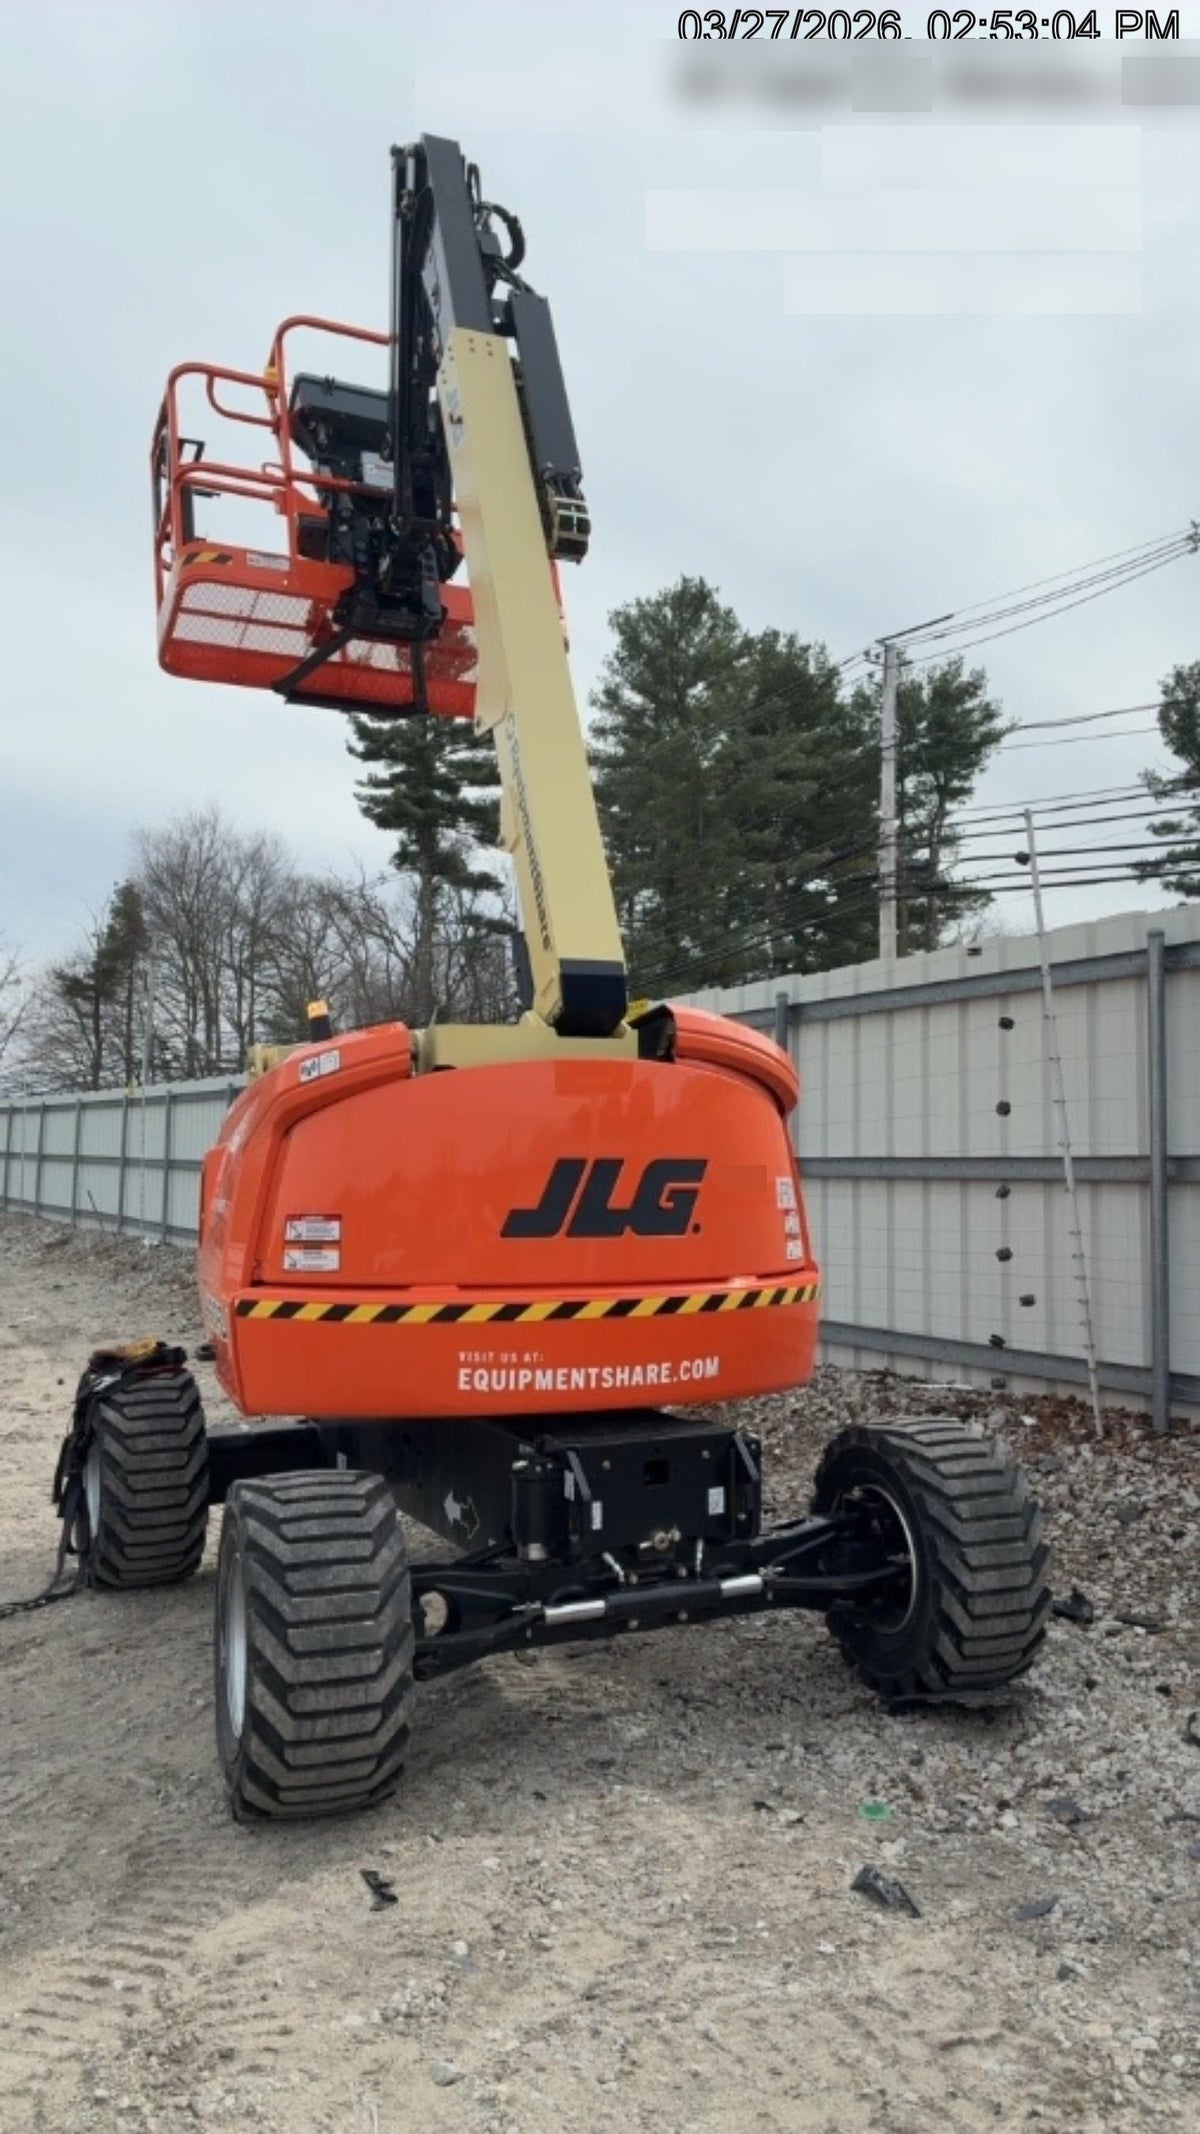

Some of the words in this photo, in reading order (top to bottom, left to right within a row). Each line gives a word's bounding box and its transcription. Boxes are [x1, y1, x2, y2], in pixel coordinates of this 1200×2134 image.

[500, 1158, 709, 1238] JLG
[458, 1356, 720, 1392] EQUIPMENTSHARE.COM
[459, 1351, 494, 1363] VISIT
[500, 1352, 518, 1364] US
[523, 1351, 545, 1363] AT:
